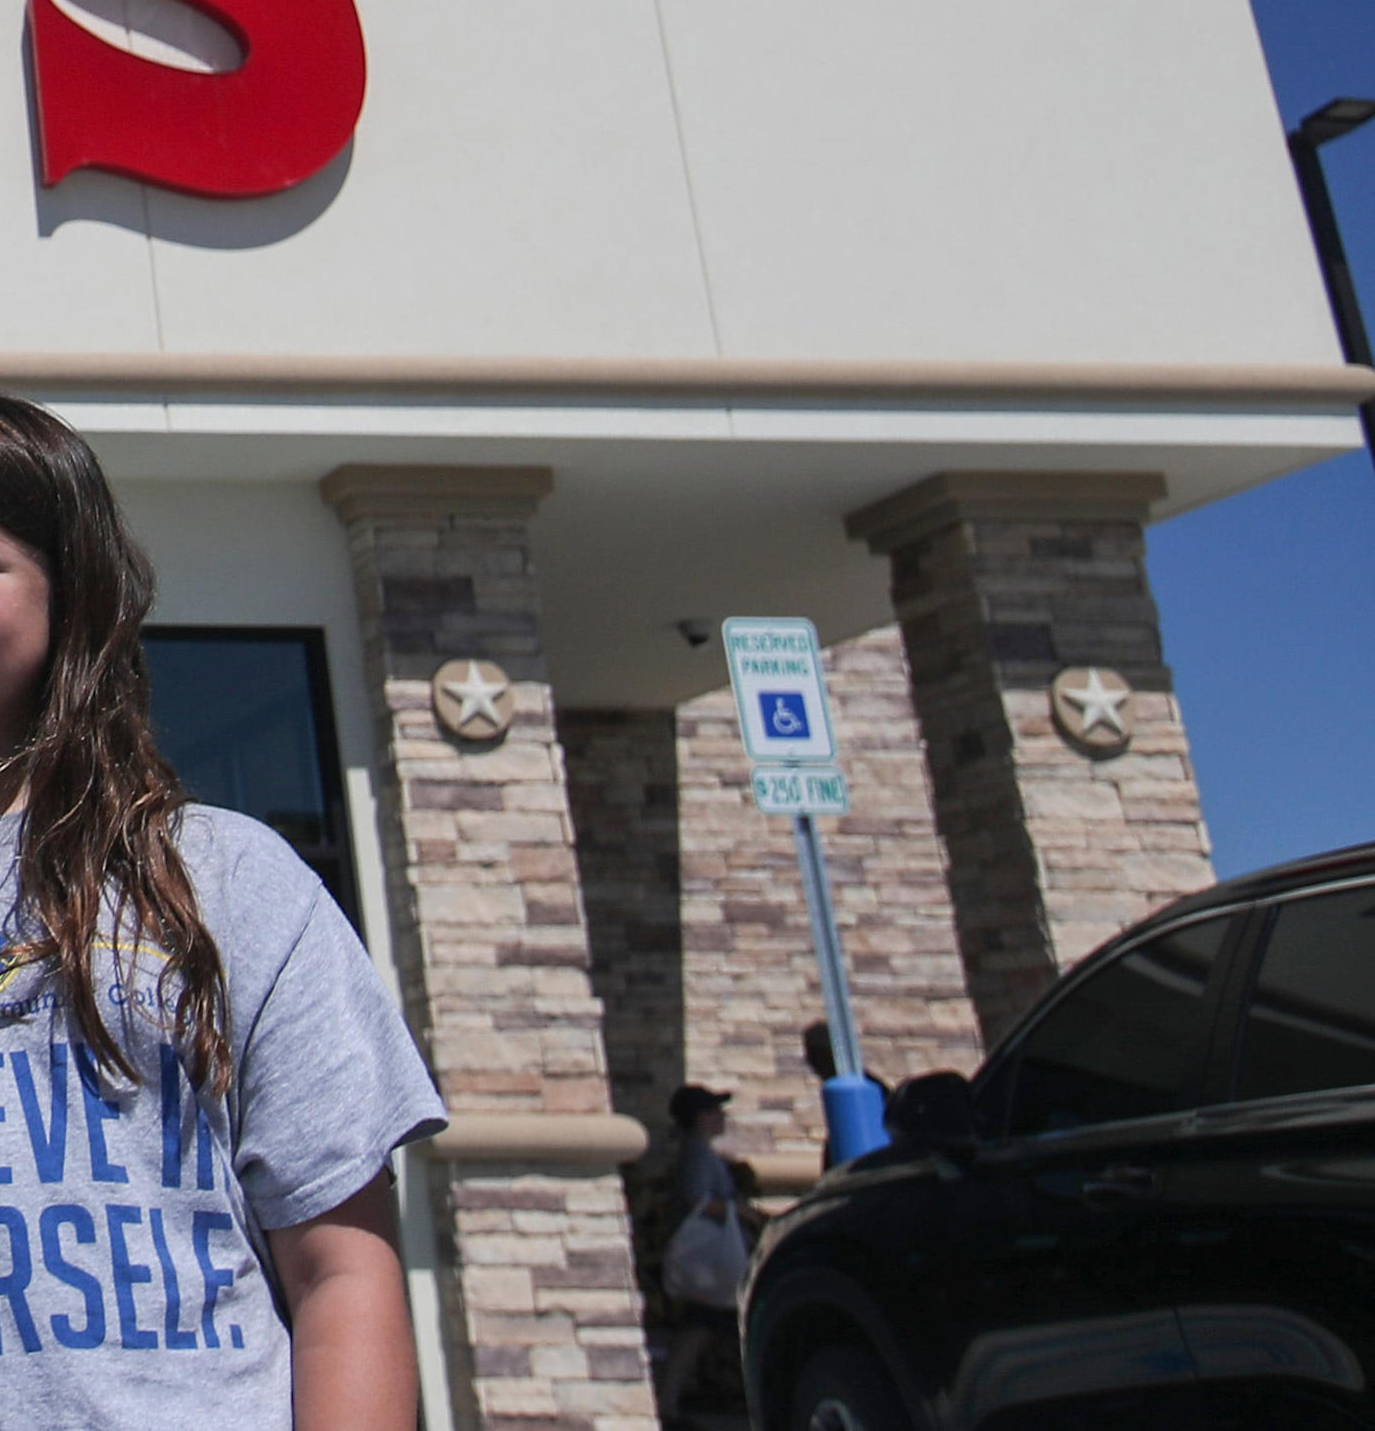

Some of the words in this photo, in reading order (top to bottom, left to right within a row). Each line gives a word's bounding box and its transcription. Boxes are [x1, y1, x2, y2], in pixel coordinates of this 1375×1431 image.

[731, 634, 809, 652] RESERVED
[741, 658, 809, 675] PARKING
[755, 774, 801, 804] $250
[806, 775, 846, 804] FINE
